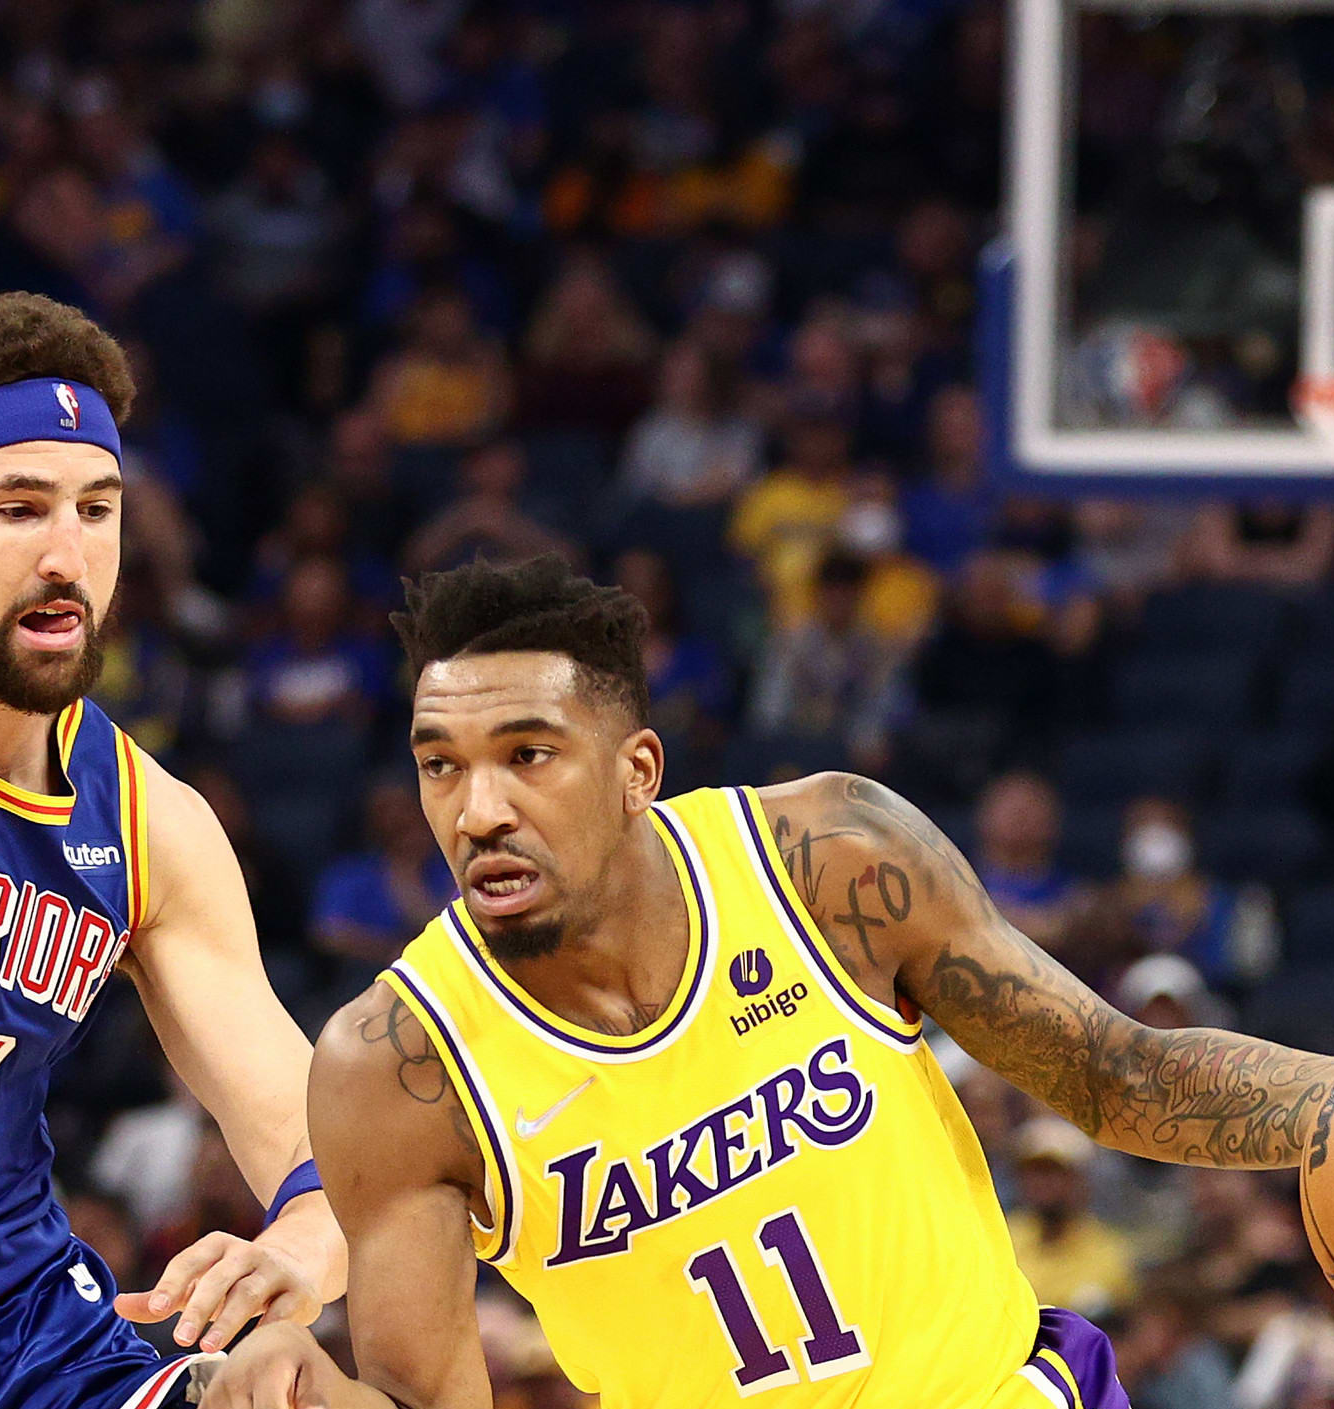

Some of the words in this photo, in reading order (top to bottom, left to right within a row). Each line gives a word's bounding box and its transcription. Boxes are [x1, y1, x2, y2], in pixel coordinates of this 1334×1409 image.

[729, 982, 808, 1037] bibigo
[544, 1034, 877, 1271] LAKERS
[683, 1206, 872, 1399] 11
